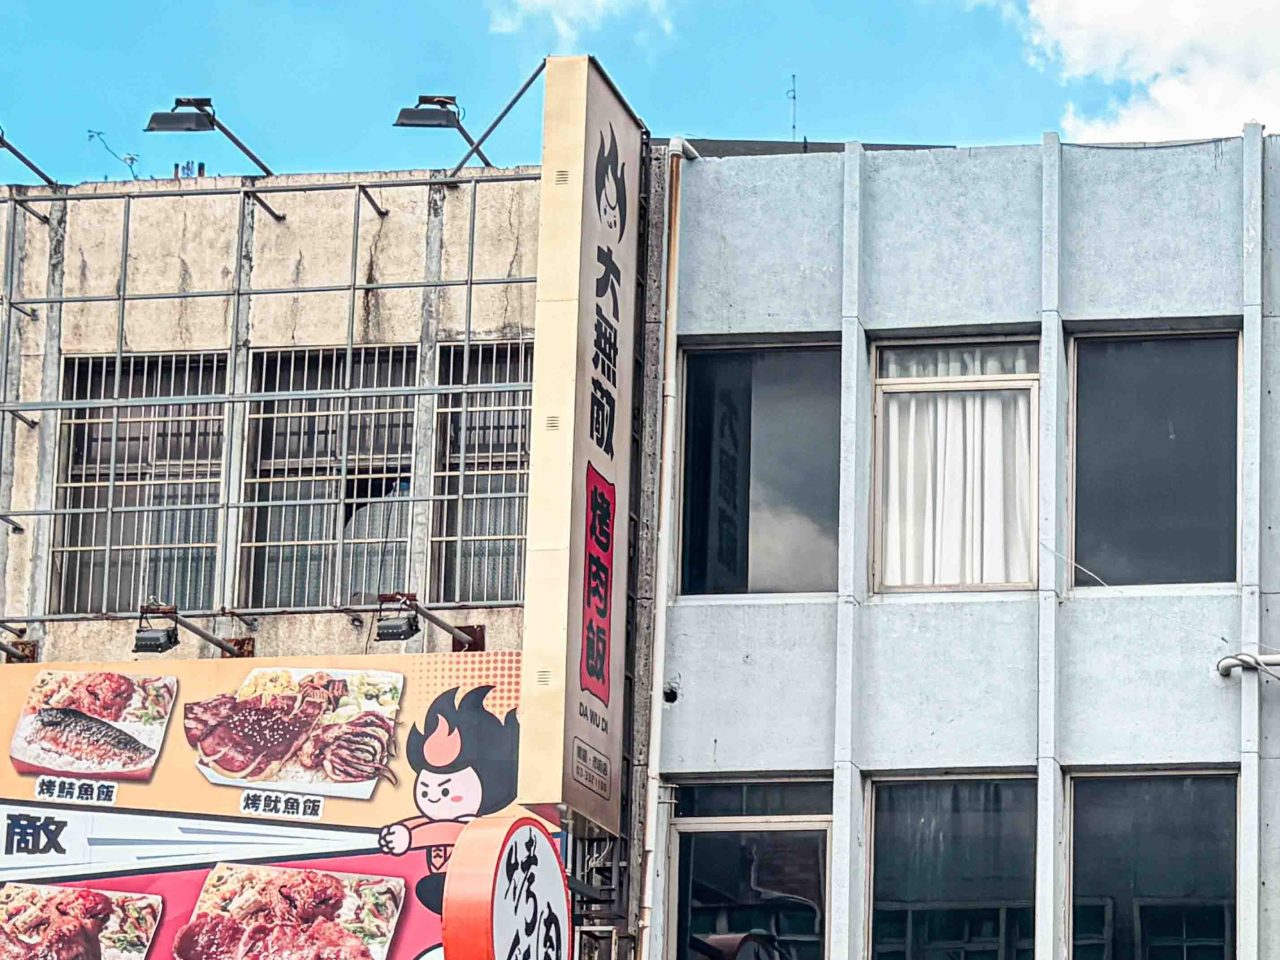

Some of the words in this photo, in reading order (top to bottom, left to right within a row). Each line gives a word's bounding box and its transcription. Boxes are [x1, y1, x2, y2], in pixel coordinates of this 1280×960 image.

[584, 485, 612, 684] 烤肉飯
[38, 779, 114, 802] 烤鯖魚飯
[244, 793, 321, 817] 烤魷魚飯
[5, 814, 68, 855] 敵
